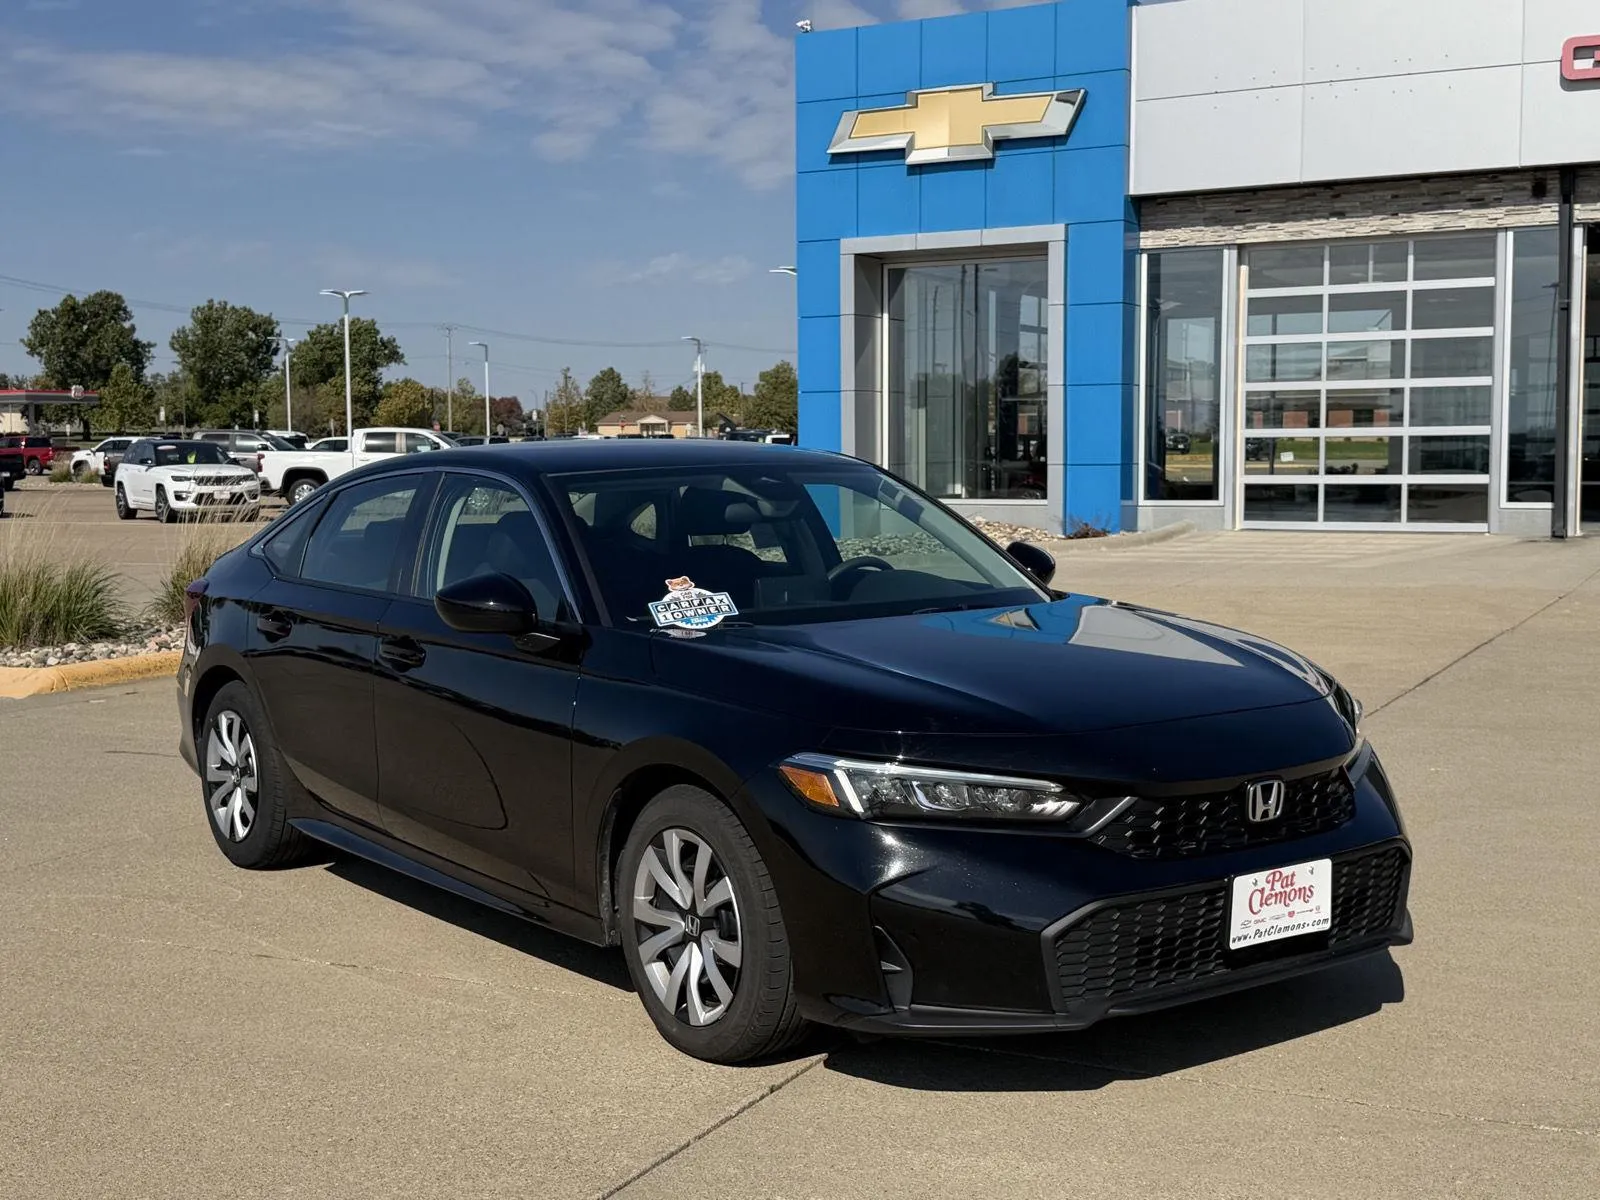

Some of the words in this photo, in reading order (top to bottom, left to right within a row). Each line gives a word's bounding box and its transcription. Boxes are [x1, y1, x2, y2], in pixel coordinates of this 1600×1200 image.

[656, 597, 727, 613] CARFAX
[1265, 870, 1296, 891] Pat
[1249, 884, 1314, 915] Clemons
